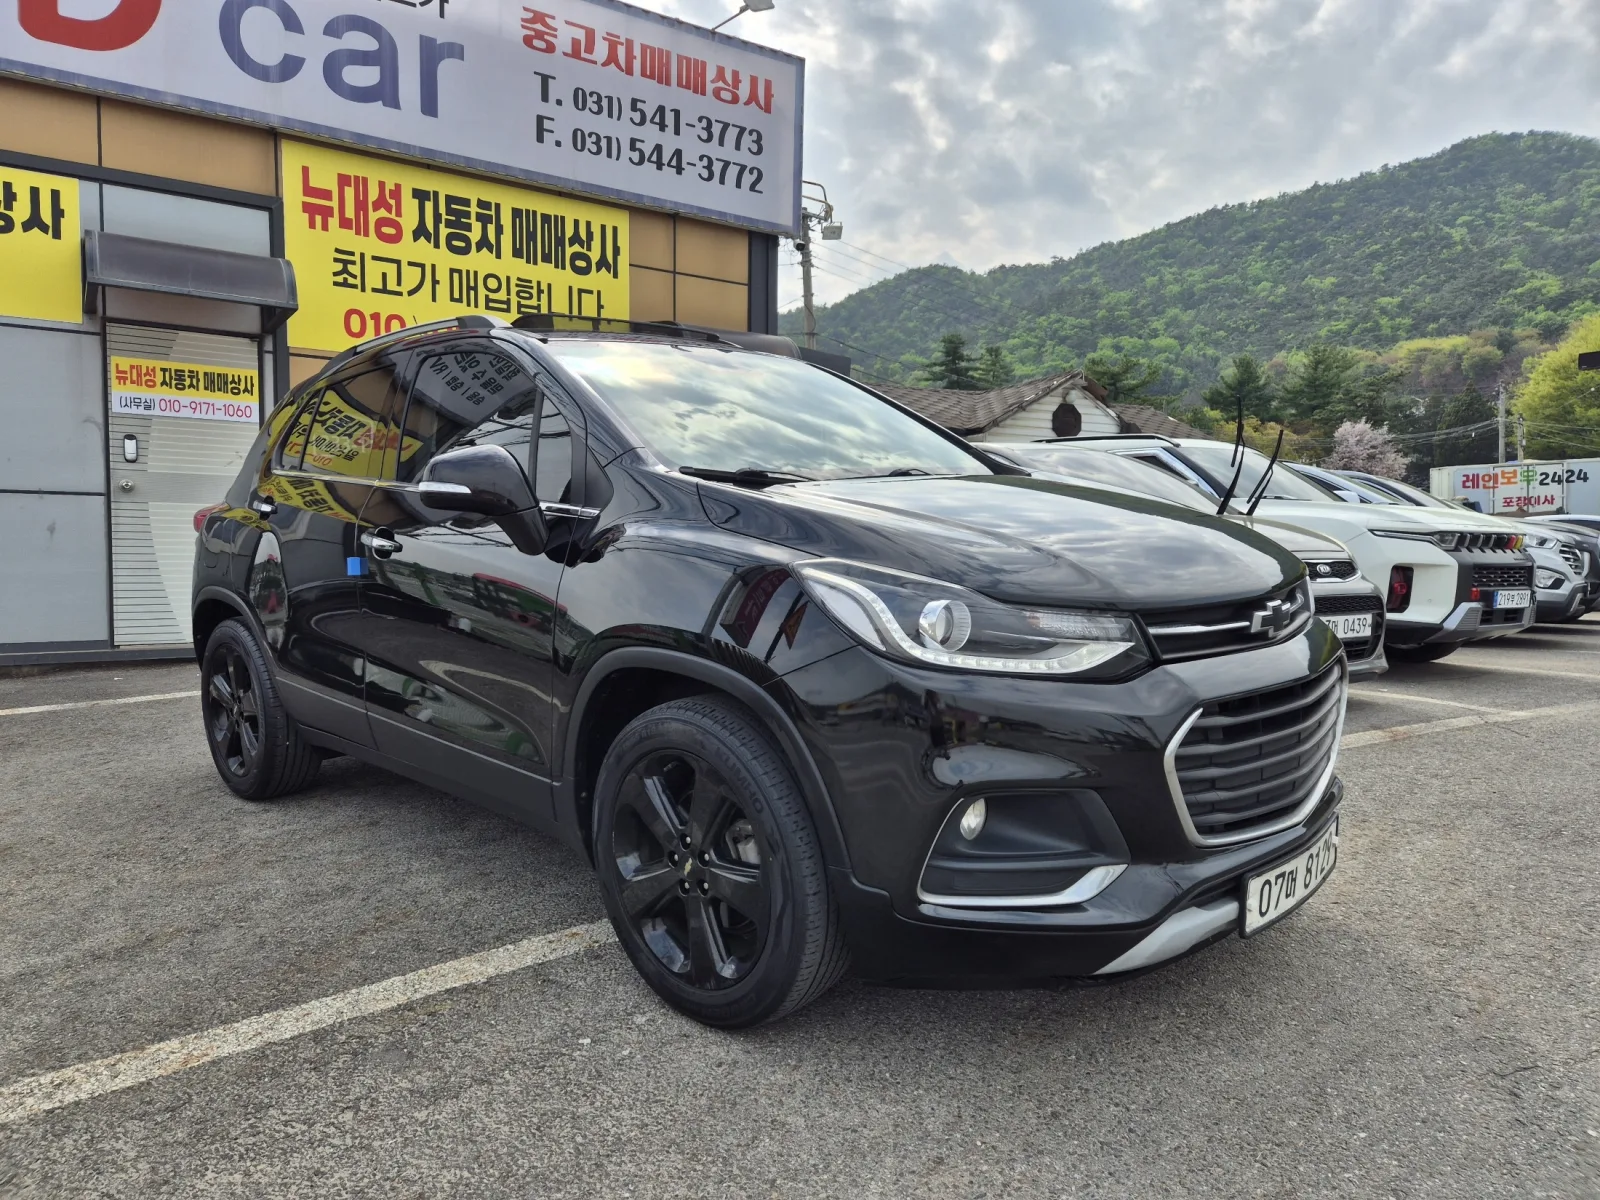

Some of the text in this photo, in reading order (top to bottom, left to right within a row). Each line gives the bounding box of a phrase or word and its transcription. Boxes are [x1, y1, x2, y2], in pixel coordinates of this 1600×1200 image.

[219, 0, 464, 118] car
[521, 5, 774, 114] 중고차매매상사
[534, 71, 764, 156] T. 031) 541-3773
[536, 114, 764, 194] F. 031) 544-3772
[301, 165, 620, 279] 뉴대성 자동차 매매상사
[332, 247, 440, 303] 최고가
[115, 363, 255, 396] 뉴대성 자동차 매매상사
[119, 396, 253, 418] (사무실) 010-9171-1060
[1343, 617, 1368, 634] 0439
[1259, 831, 1333, 917] 07머 8129
